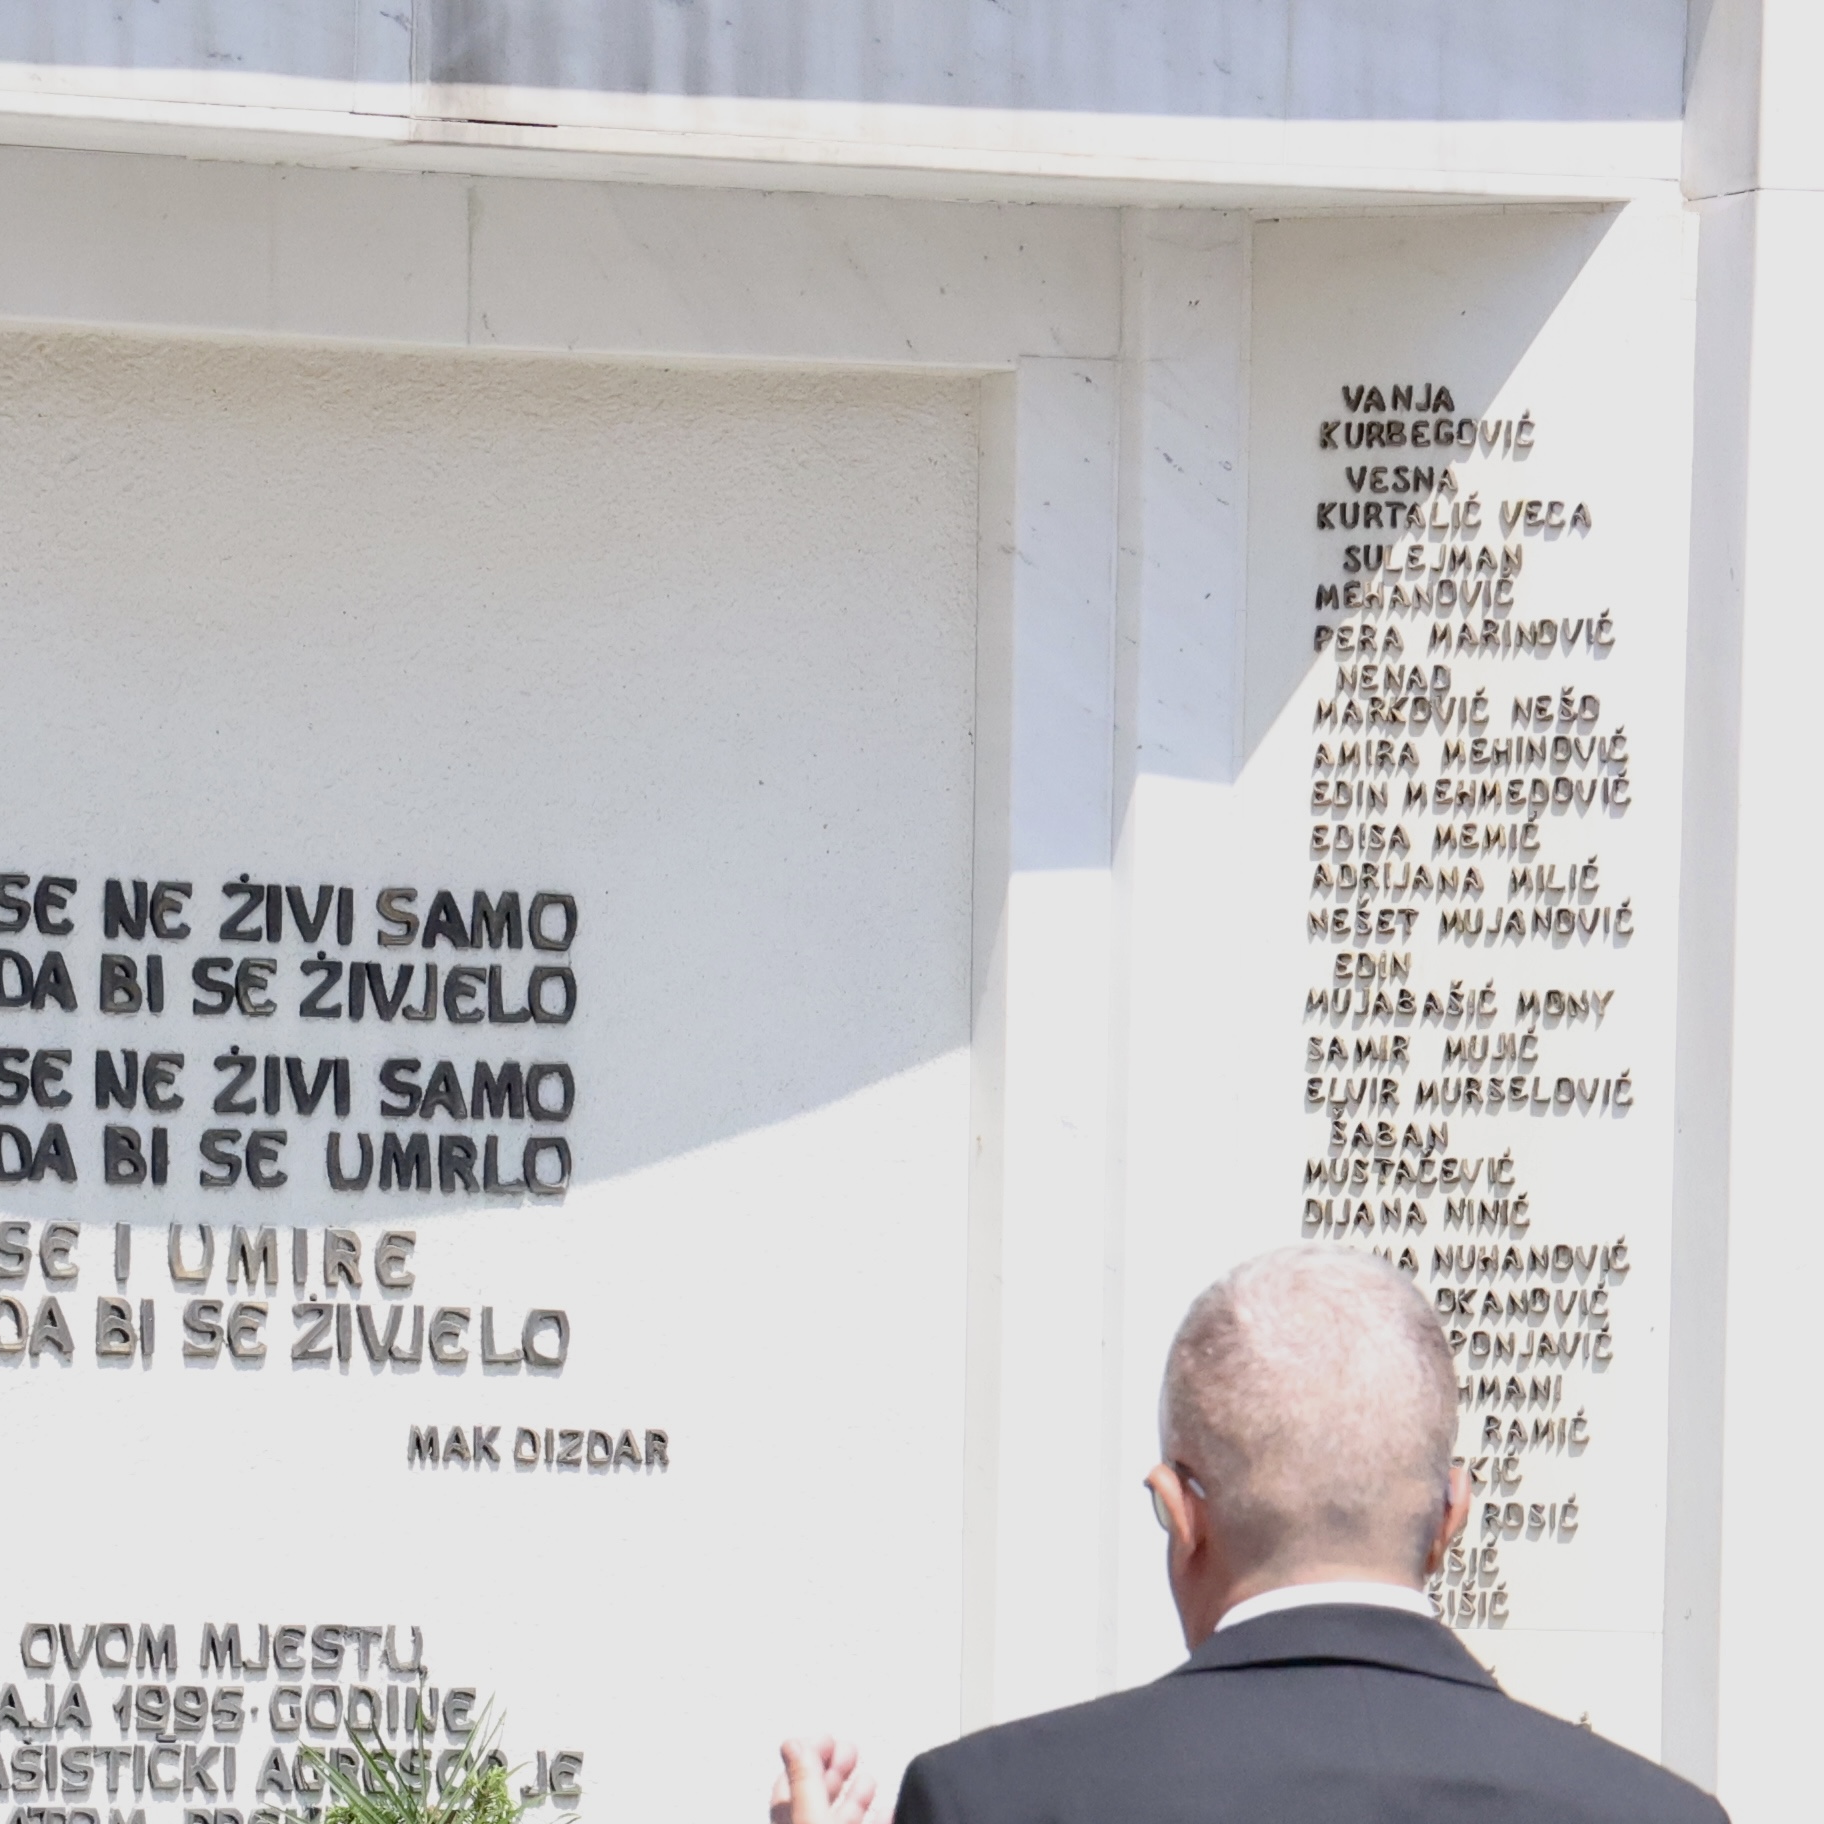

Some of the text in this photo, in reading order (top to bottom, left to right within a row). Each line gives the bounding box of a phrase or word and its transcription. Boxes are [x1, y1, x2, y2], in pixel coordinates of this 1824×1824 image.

[1342, 383, 1455, 413] VANJA
[1344, 466, 1458, 494] VESNA
[1501, 500, 1592, 530] VECA
[1342, 544, 1523, 574] SULEJMAN
[1313, 623, 1405, 652] PERA
[1336, 664, 1452, 692] NENAD
[1314, 739, 1420, 769] AMIRA
[1311, 779, 1389, 808] EDIN
[1311, 822, 1411, 851] EDISA
[1312, 862, 1485, 892] ADRIJANA
[104, 879, 192, 941] NE
[220, 873, 354, 946] ŽIVI
[378, 887, 578, 952] SAMO
[1334, 951, 1412, 980] EDIN
[99, 954, 164, 1015] BI
[192, 957, 278, 1017] SE
[299, 950, 577, 1024] ŽIVJELO
[1515, 988, 1616, 1018] MONY
[1306, 1034, 1411, 1063] SAMIR
[95, 1049, 185, 1114] NE
[213, 1045, 351, 1117] ŽIVI
[380, 1057, 576, 1121] SAMO
[1306, 1076, 1401, 1105] ELVIR
[104, 1126, 168, 1186] BI
[199, 1128, 288, 1189] SE
[326, 1134, 571, 1195] UMRLO
[1302, 1197, 1428, 1227] DIJANA
[114, 1221, 131, 1282] I
[168, 1222, 417, 1288] UMIRE
[95, 1297, 155, 1360] BI
[181, 1298, 269, 1361] SE
[291, 1293, 570, 1367] ŽIVJELO
[407, 1425, 670, 1467] MAK DIZDAR
[20, 1622, 177, 1671] OVOM
[199, 1622, 424, 1673] MJESTU
[269, 1684, 477, 1733] GODINE
[520, 1749, 585, 1800] JE
